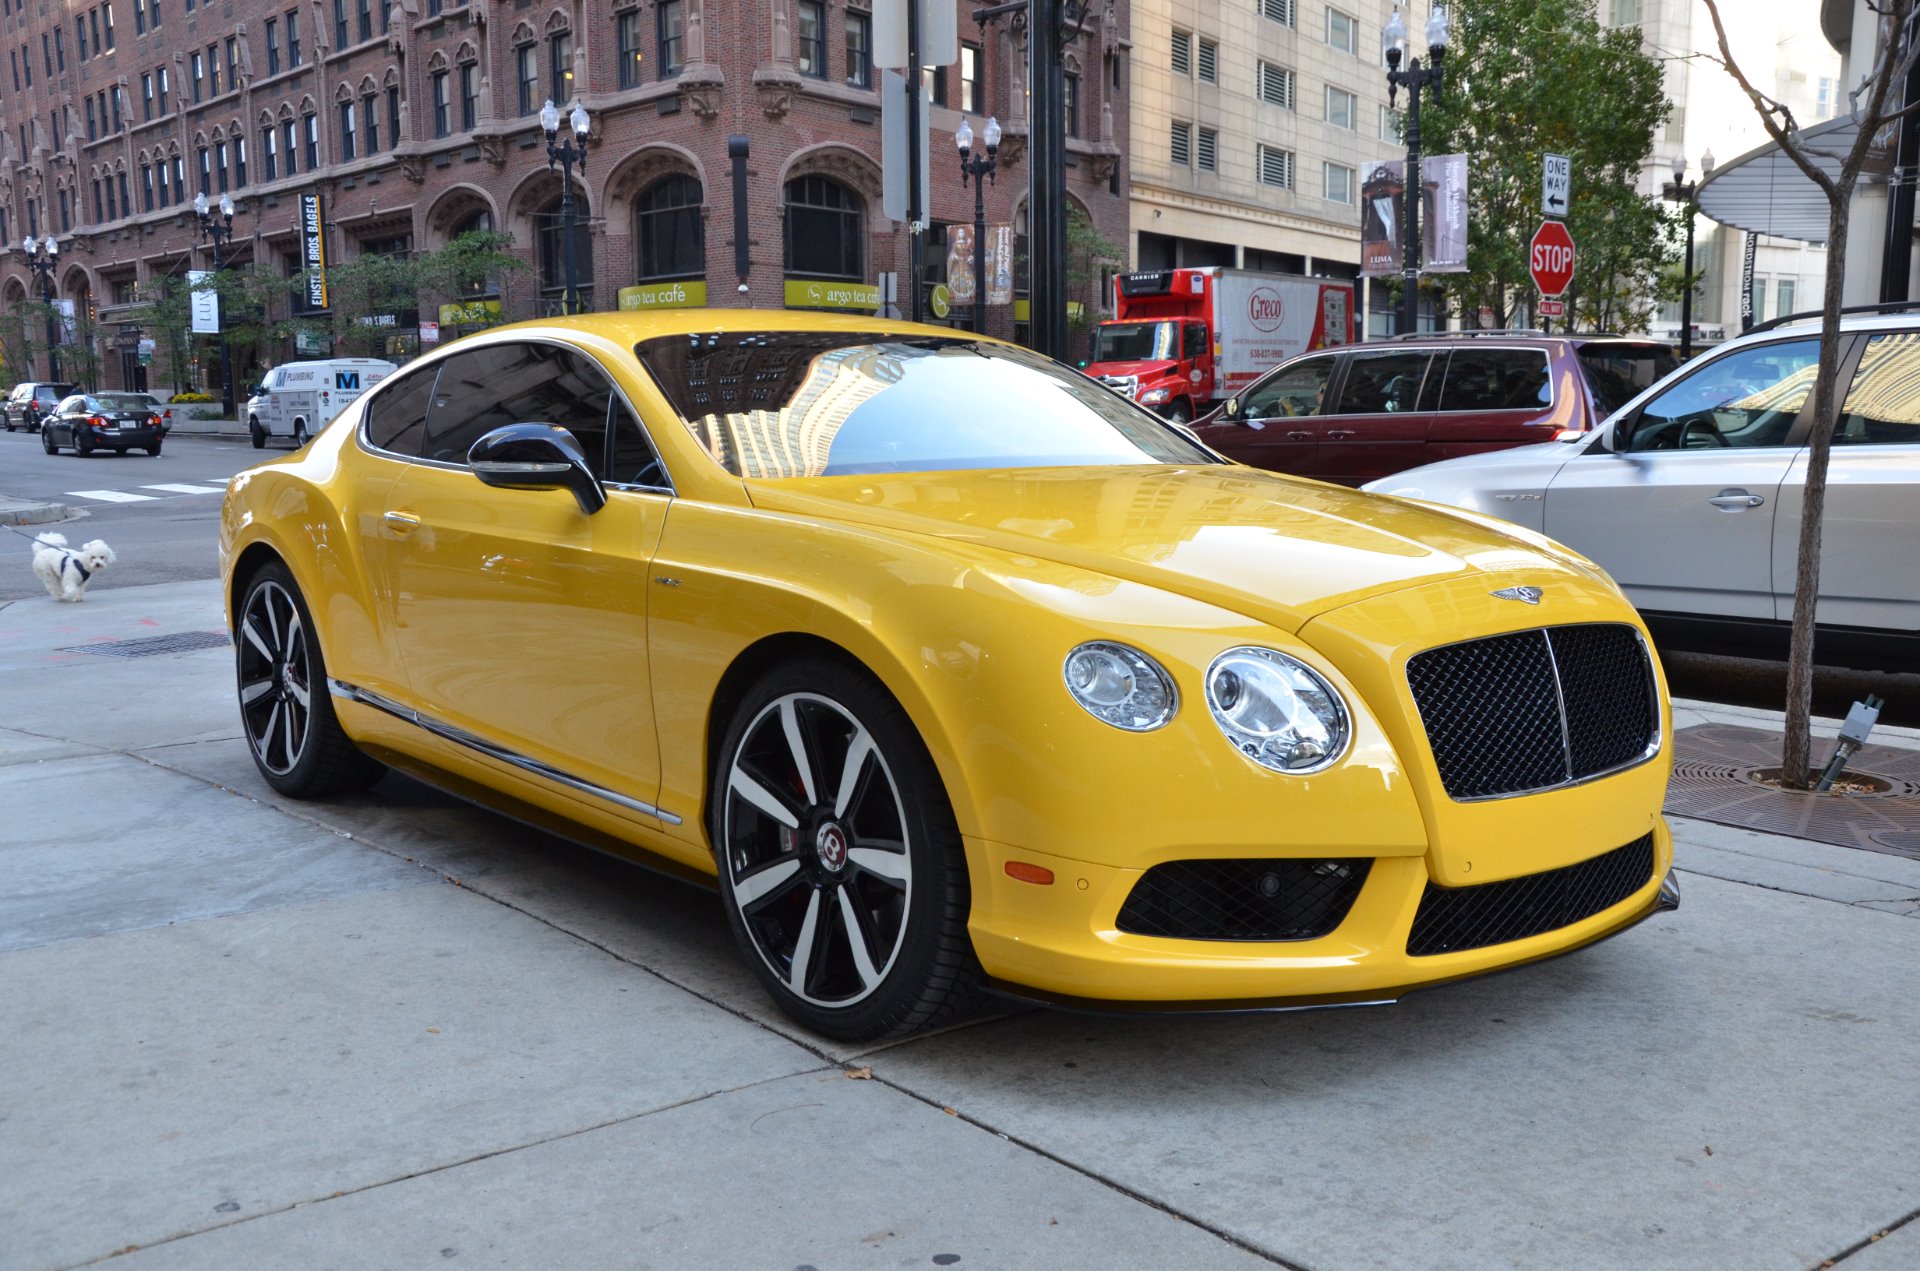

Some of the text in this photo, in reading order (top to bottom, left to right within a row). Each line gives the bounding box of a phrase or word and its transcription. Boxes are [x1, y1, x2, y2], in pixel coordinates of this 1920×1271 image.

[1547, 160, 1567, 175] ONE
[1547, 176, 1567, 192] WAY
[305, 196, 319, 232] BAGELS
[1370, 255, 1393, 264] LUMA
[1533, 244, 1572, 273] STOP
[1742, 233, 1755, 317] NORDSTROM rack
[642, 292, 656, 304] tea
[658, 284, 686, 302] café
[827, 290, 851, 305] argo
[853, 290, 866, 303] tea
[1250, 294, 1281, 320] Greco
[1541, 303, 1561, 313] ALL WAY
[1709, 328, 1726, 339] rack
[287, 371, 314, 381] PLUMBING
[335, 373, 360, 389] M
